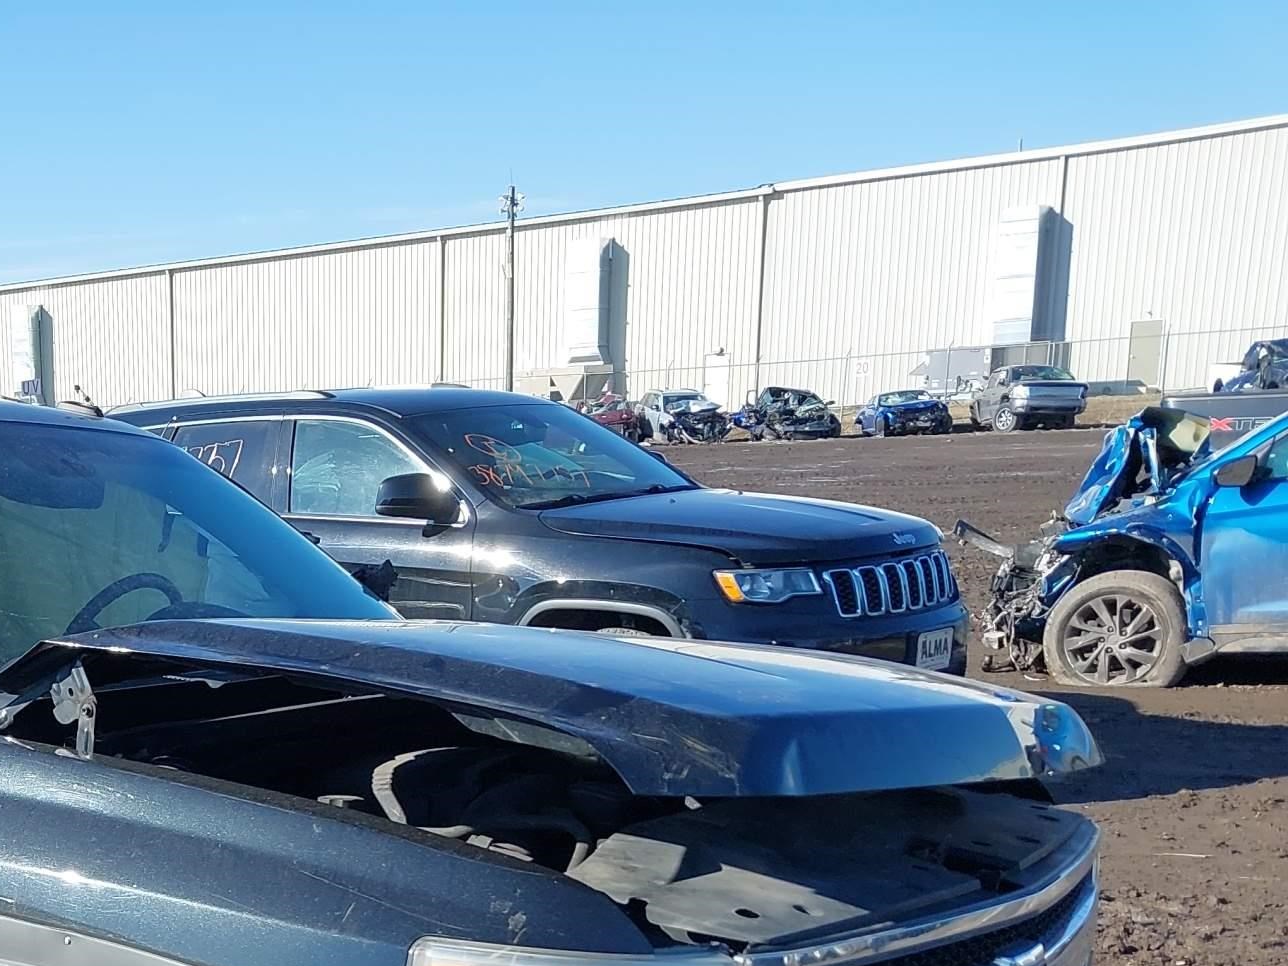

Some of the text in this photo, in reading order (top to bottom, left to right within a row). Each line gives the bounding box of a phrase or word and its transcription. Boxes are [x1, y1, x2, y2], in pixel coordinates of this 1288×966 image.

[856, 362, 869, 374] 20
[22, 380, 39, 395] UV
[893, 532, 916, 545] Jeep
[921, 637, 949, 660] ALMA
